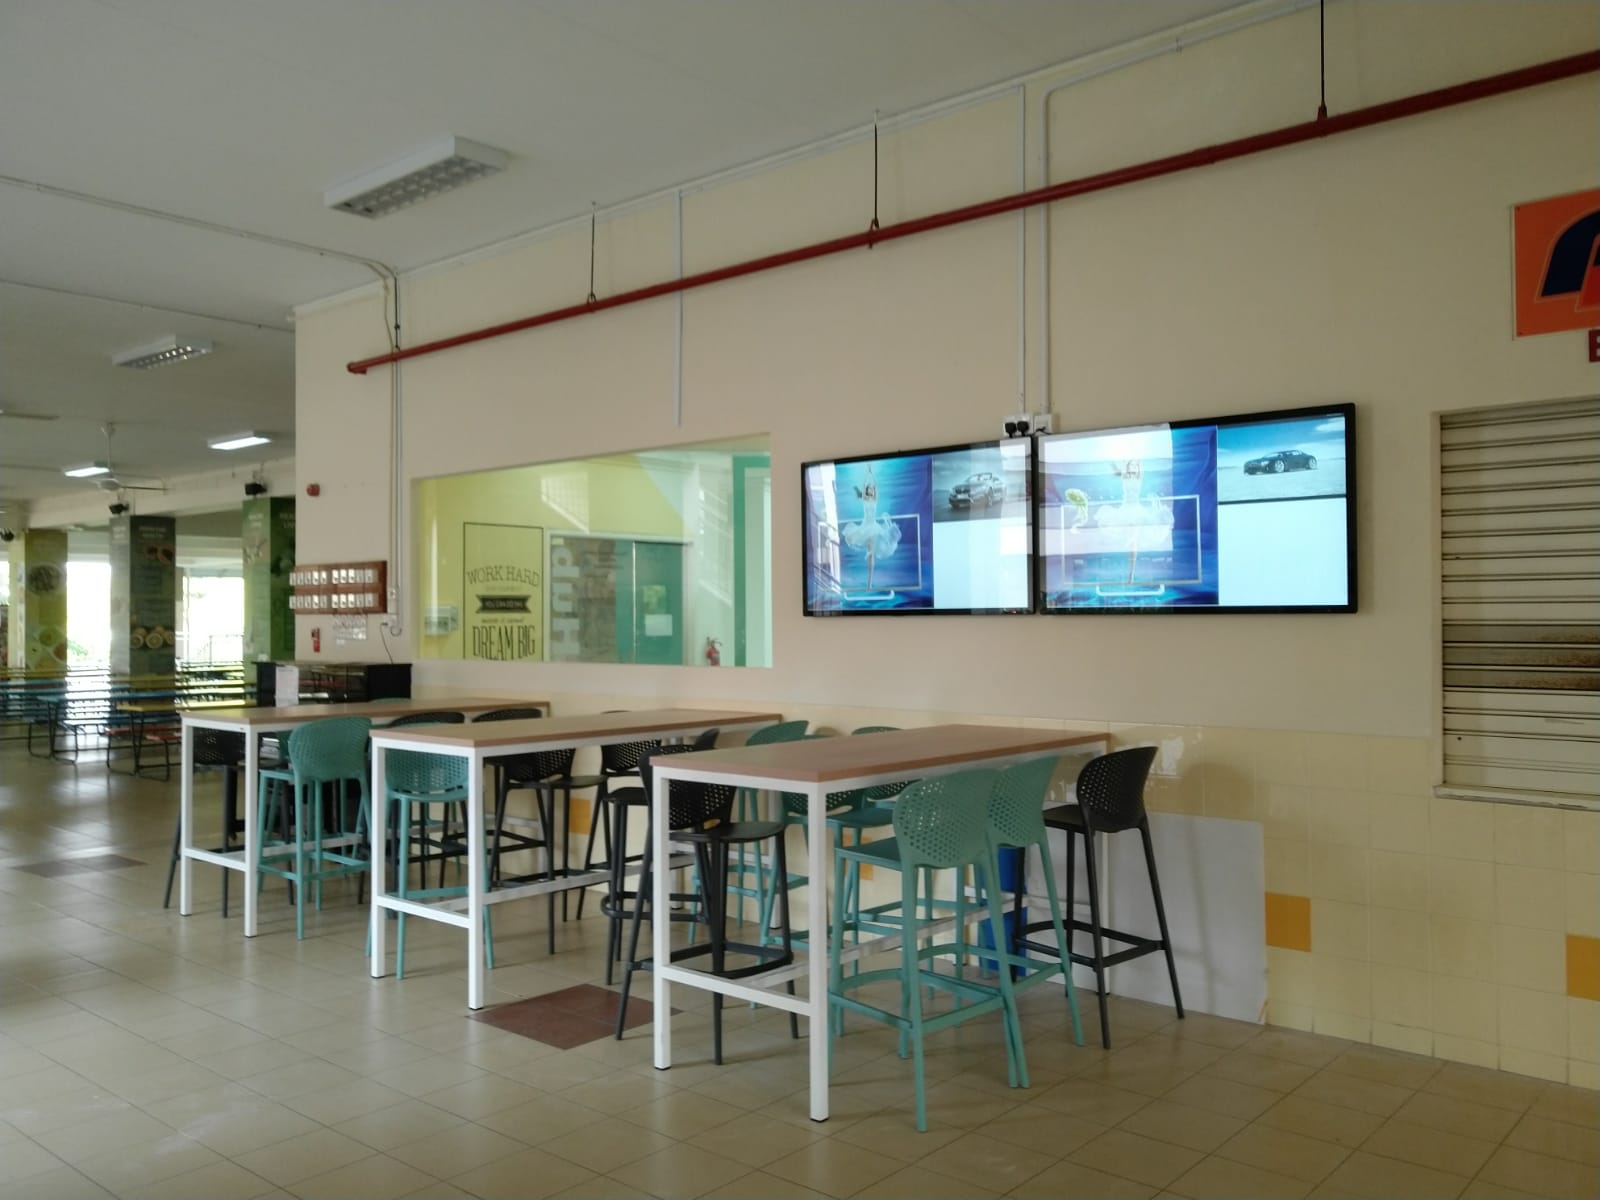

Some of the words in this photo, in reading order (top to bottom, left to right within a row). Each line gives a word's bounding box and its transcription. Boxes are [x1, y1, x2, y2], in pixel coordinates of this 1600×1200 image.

[466, 565, 503, 585] WORK
[505, 565, 540, 587] HARD
[472, 625, 514, 661] DREAM
[517, 624, 536, 659] BIG
